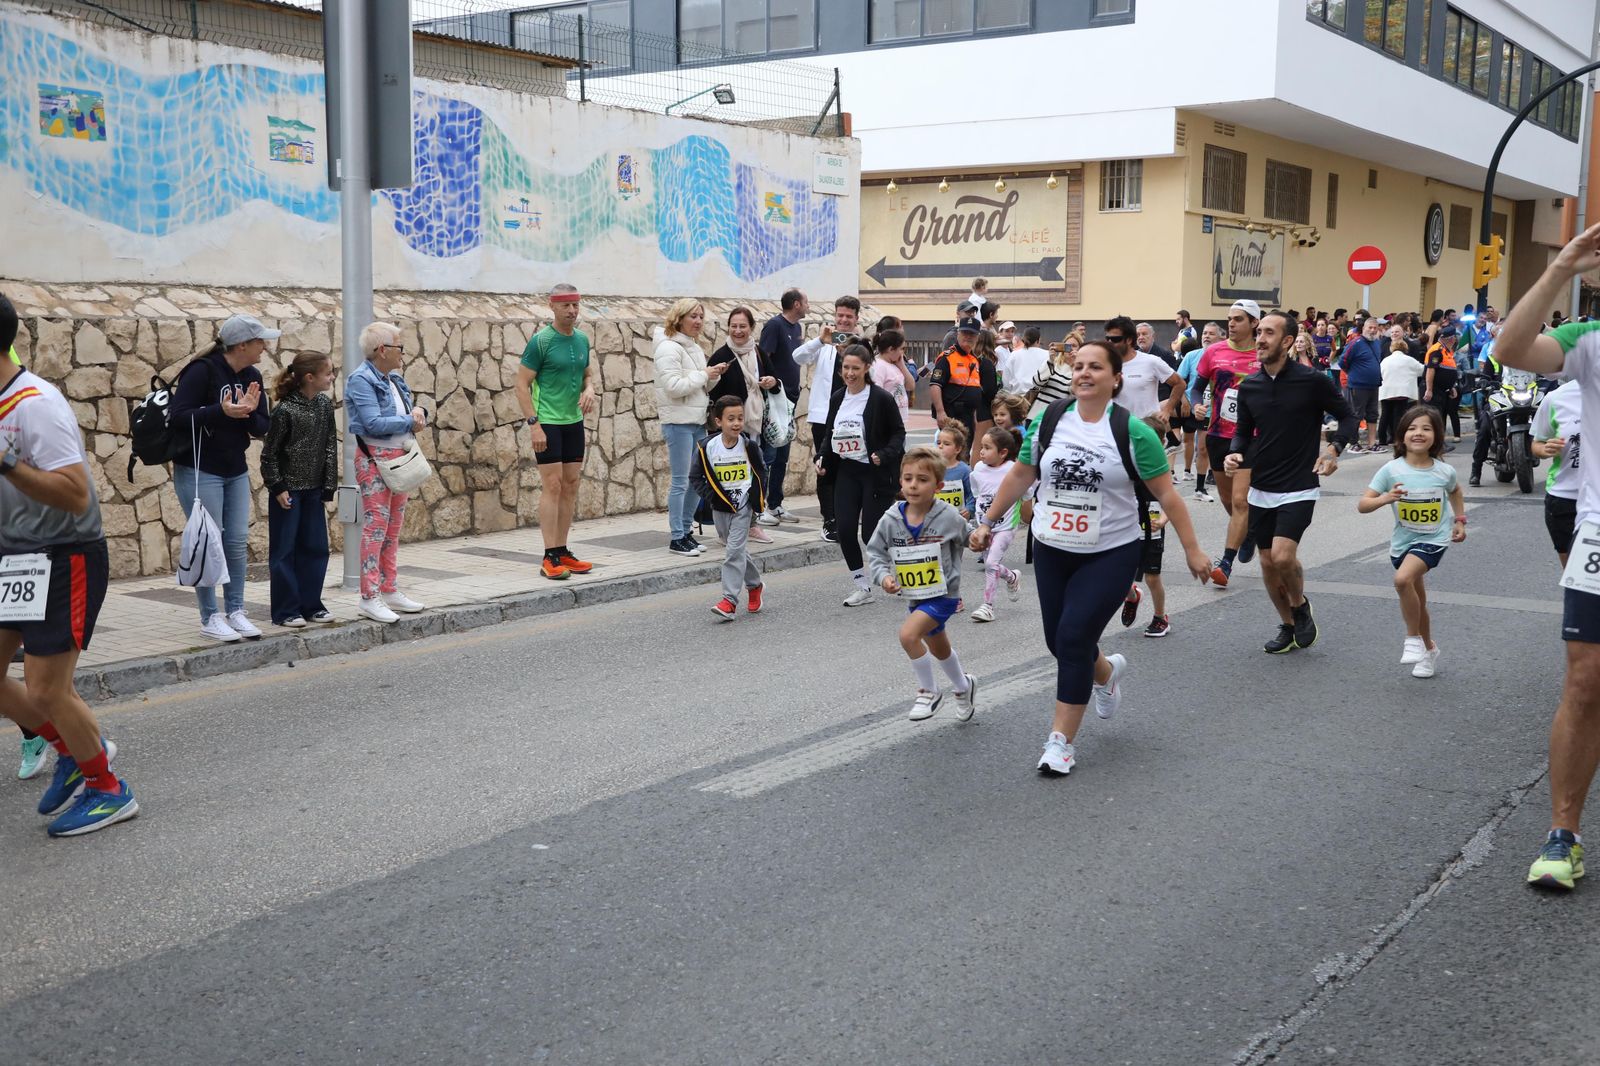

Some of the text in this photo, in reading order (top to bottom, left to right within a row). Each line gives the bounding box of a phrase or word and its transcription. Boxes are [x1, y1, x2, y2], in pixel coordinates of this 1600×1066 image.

[889, 196, 908, 211] LE
[900, 190, 1019, 260] Grand
[1009, 227, 1050, 244] CAFÉ
[1230, 241, 1267, 287] Grand
[837, 440, 861, 453] 212
[717, 469, 746, 482] 1073
[1050, 511, 1089, 533] 256
[1401, 508, 1438, 523] 1058
[898, 568, 938, 587] 1012
[1, 580, 36, 603] 798
